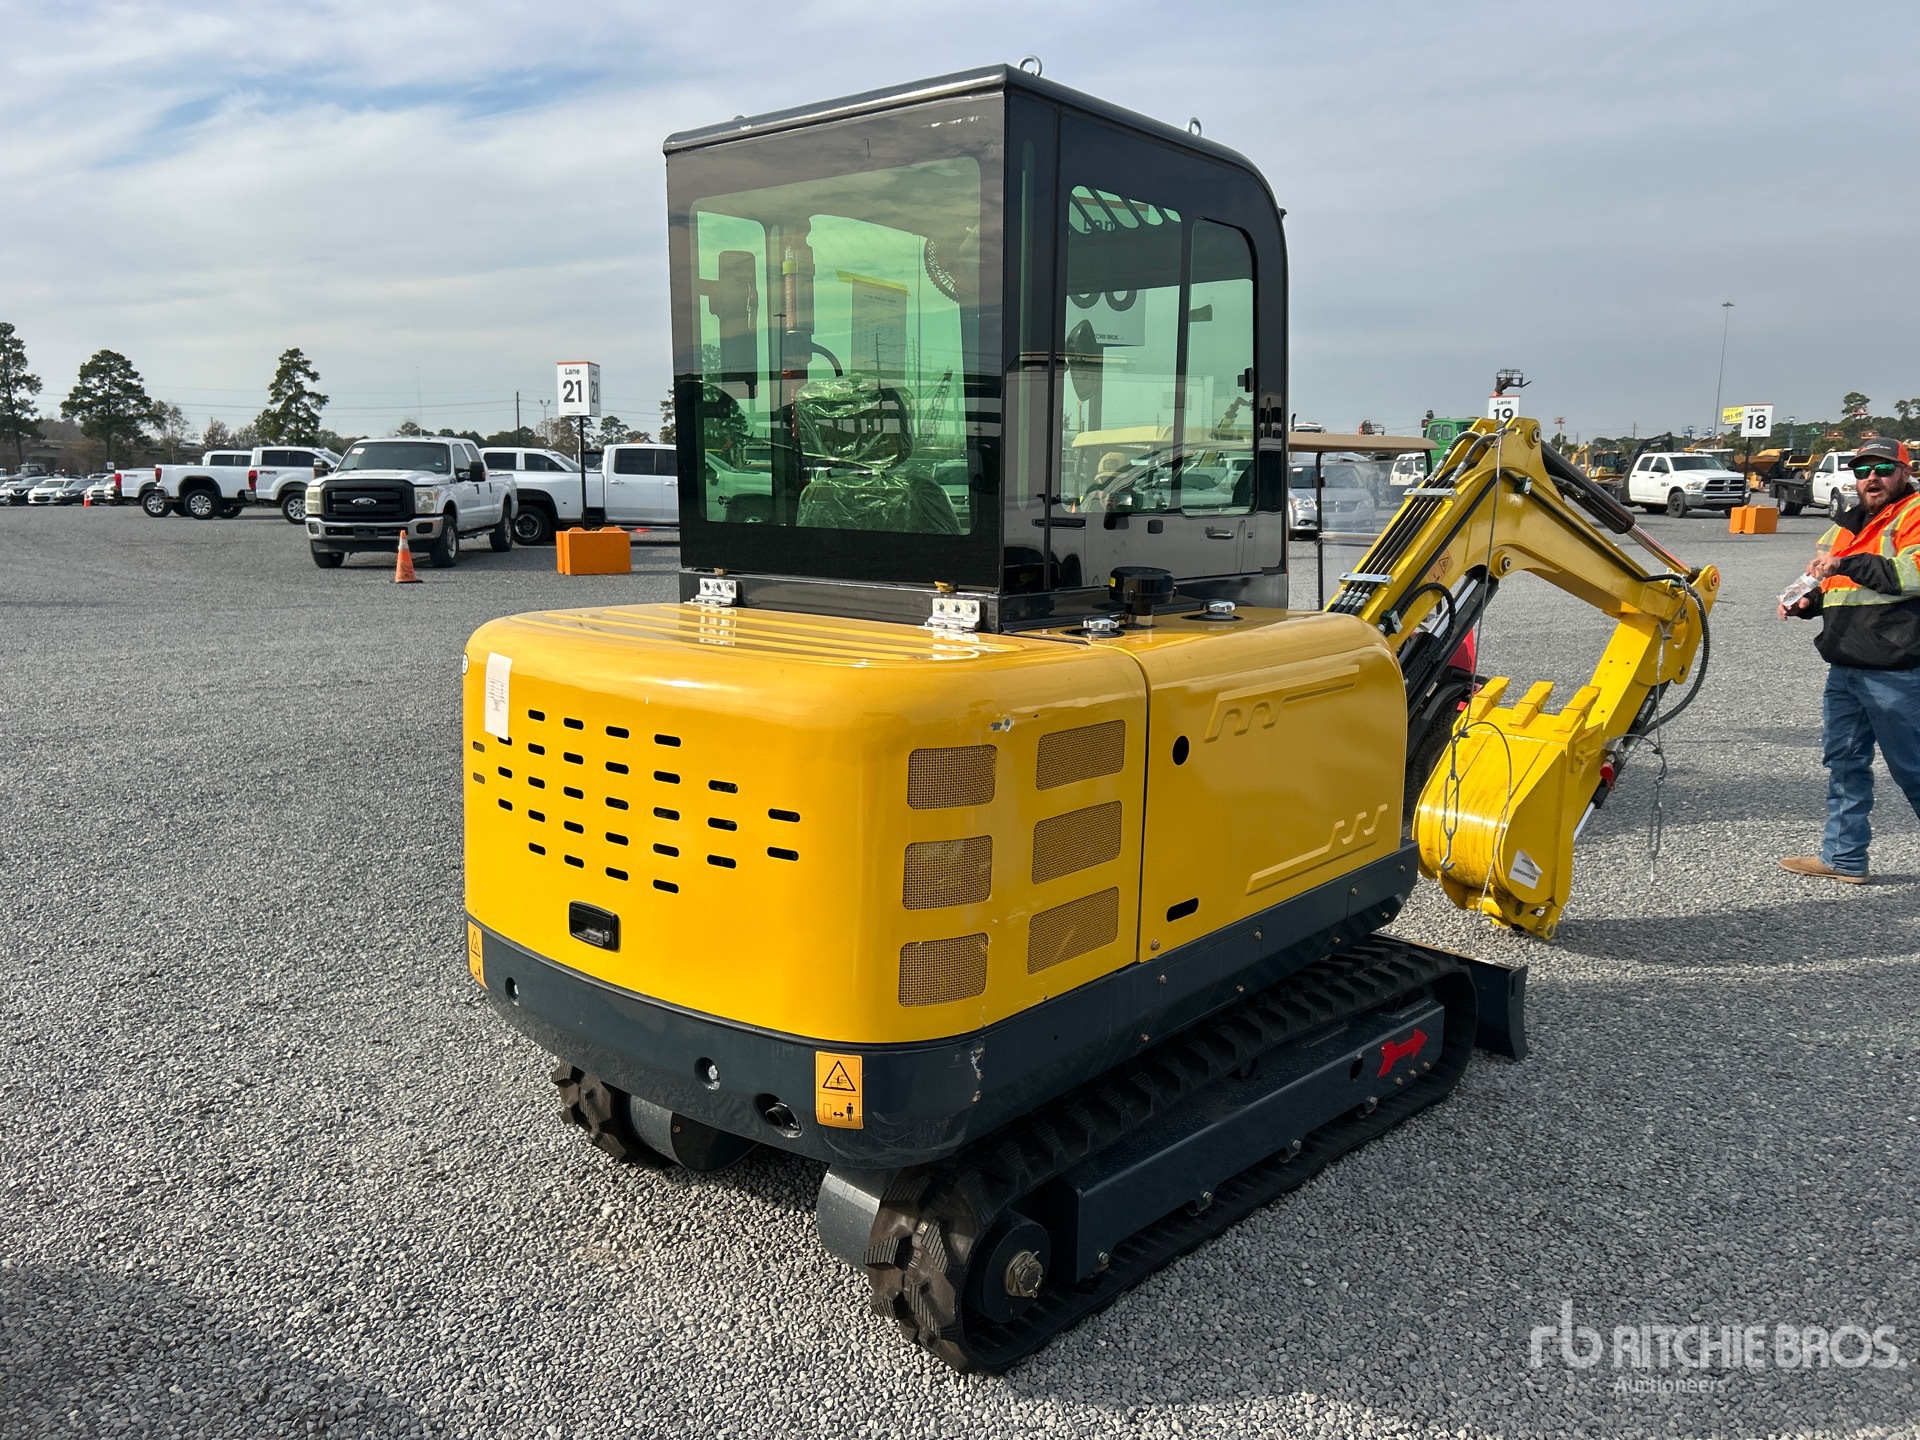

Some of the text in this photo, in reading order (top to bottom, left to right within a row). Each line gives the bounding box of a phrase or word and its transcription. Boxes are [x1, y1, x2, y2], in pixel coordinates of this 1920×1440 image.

[1084, 217, 1114, 231] Lan
[563, 379, 582, 403] 21
[591, 380, 599, 404] 21
[1747, 415, 1767, 430] 18
